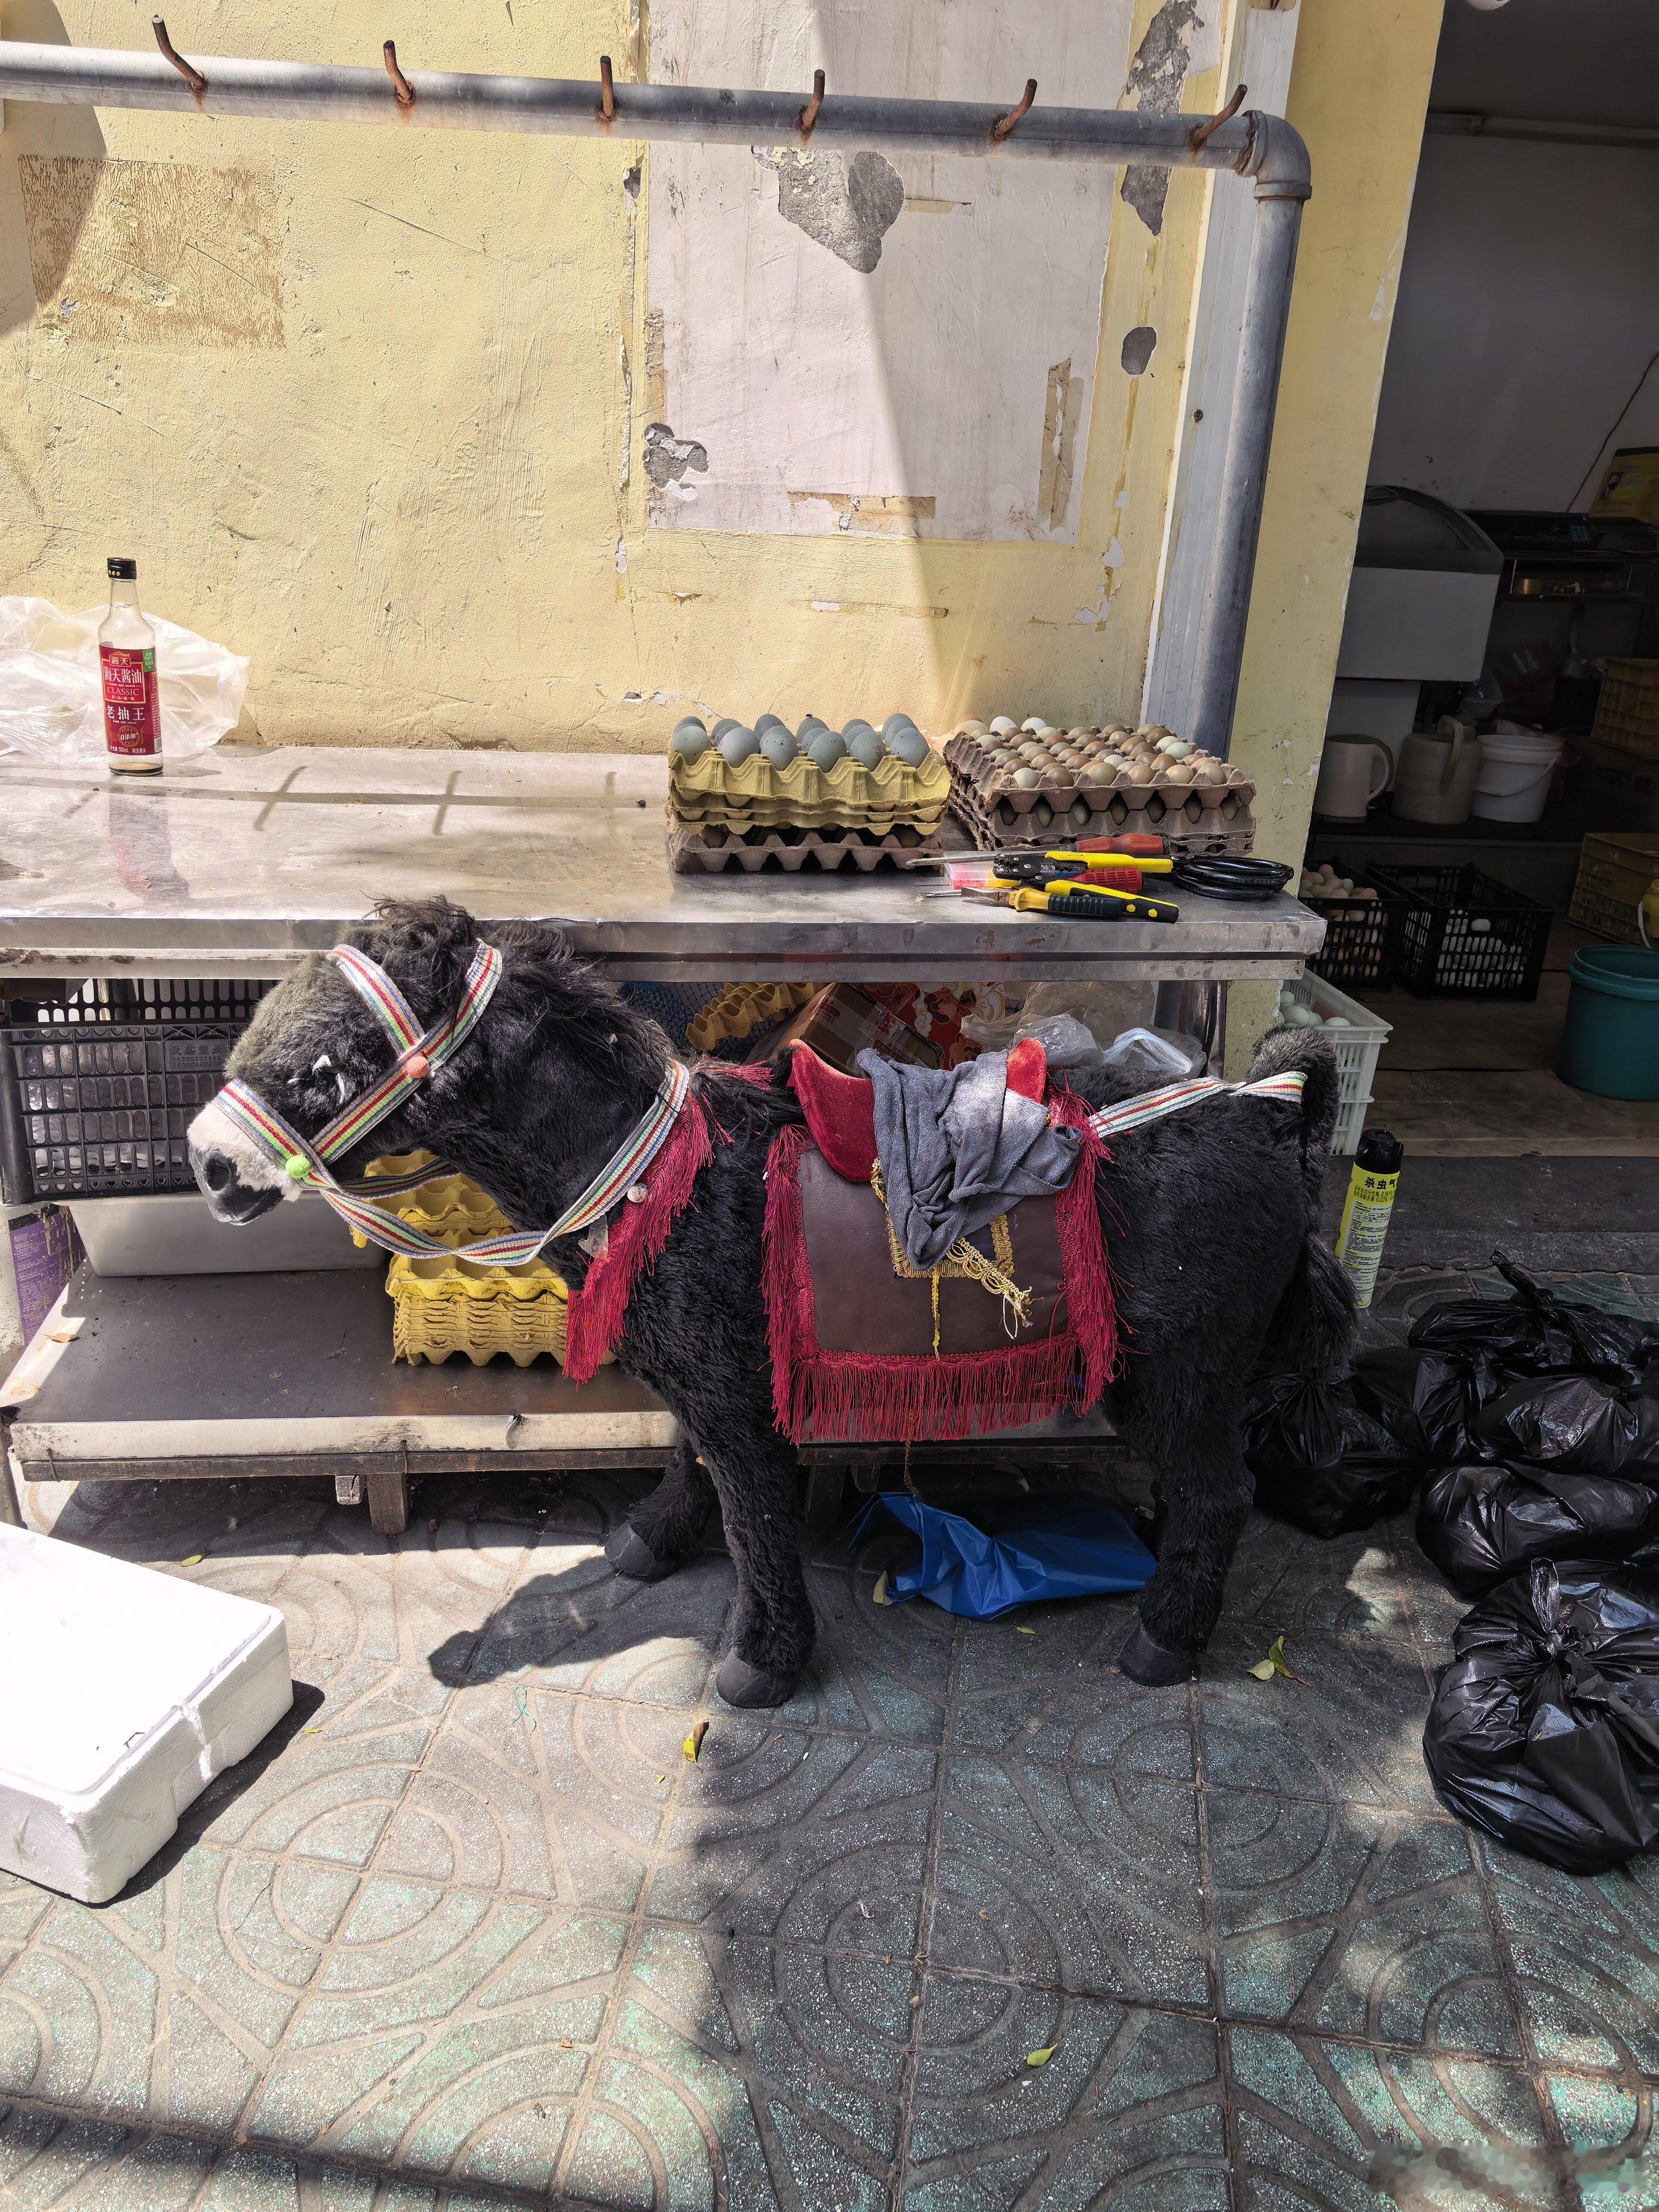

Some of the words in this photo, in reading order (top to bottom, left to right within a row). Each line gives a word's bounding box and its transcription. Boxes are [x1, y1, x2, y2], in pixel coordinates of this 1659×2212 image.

[104, 665, 141, 684] 海天酱油
[107, 686, 139, 696] CLASSIC
[106, 704, 145, 720] 老抽王
